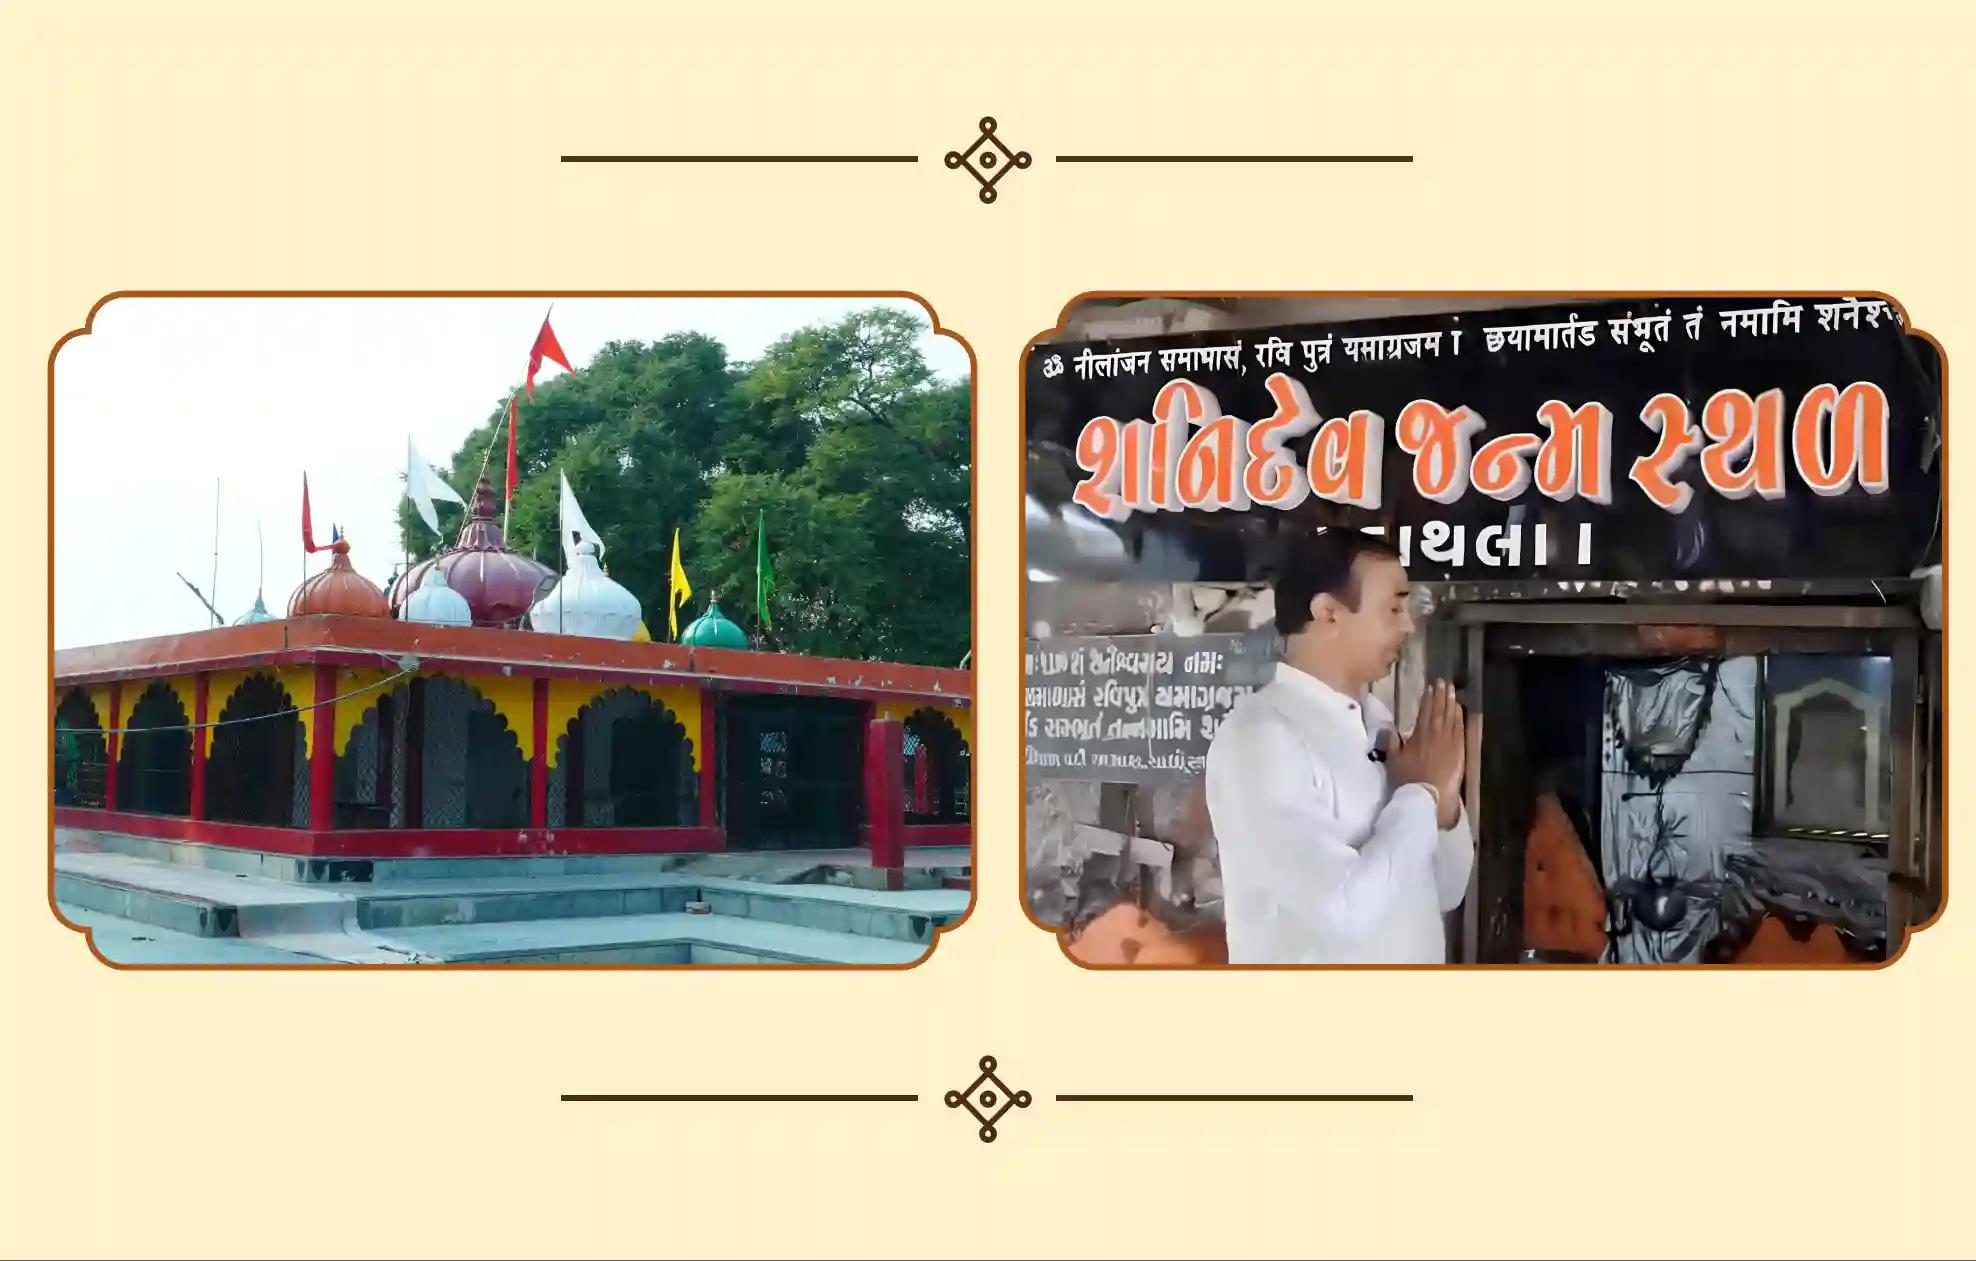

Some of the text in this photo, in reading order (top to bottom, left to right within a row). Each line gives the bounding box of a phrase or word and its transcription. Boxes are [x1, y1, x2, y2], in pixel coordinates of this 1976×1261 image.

[1073, 347, 1153, 380] नीलांजन
[1254, 336, 1294, 368] रवि
[1300, 333, 1333, 373] पुत्रं
[1607, 308, 1672, 353] संभूतं
[1682, 305, 1704, 341] तं
[1718, 299, 1804, 337] नमामि
[1073, 372, 1891, 523] શનિદેવ જન્મ સ્થળ
